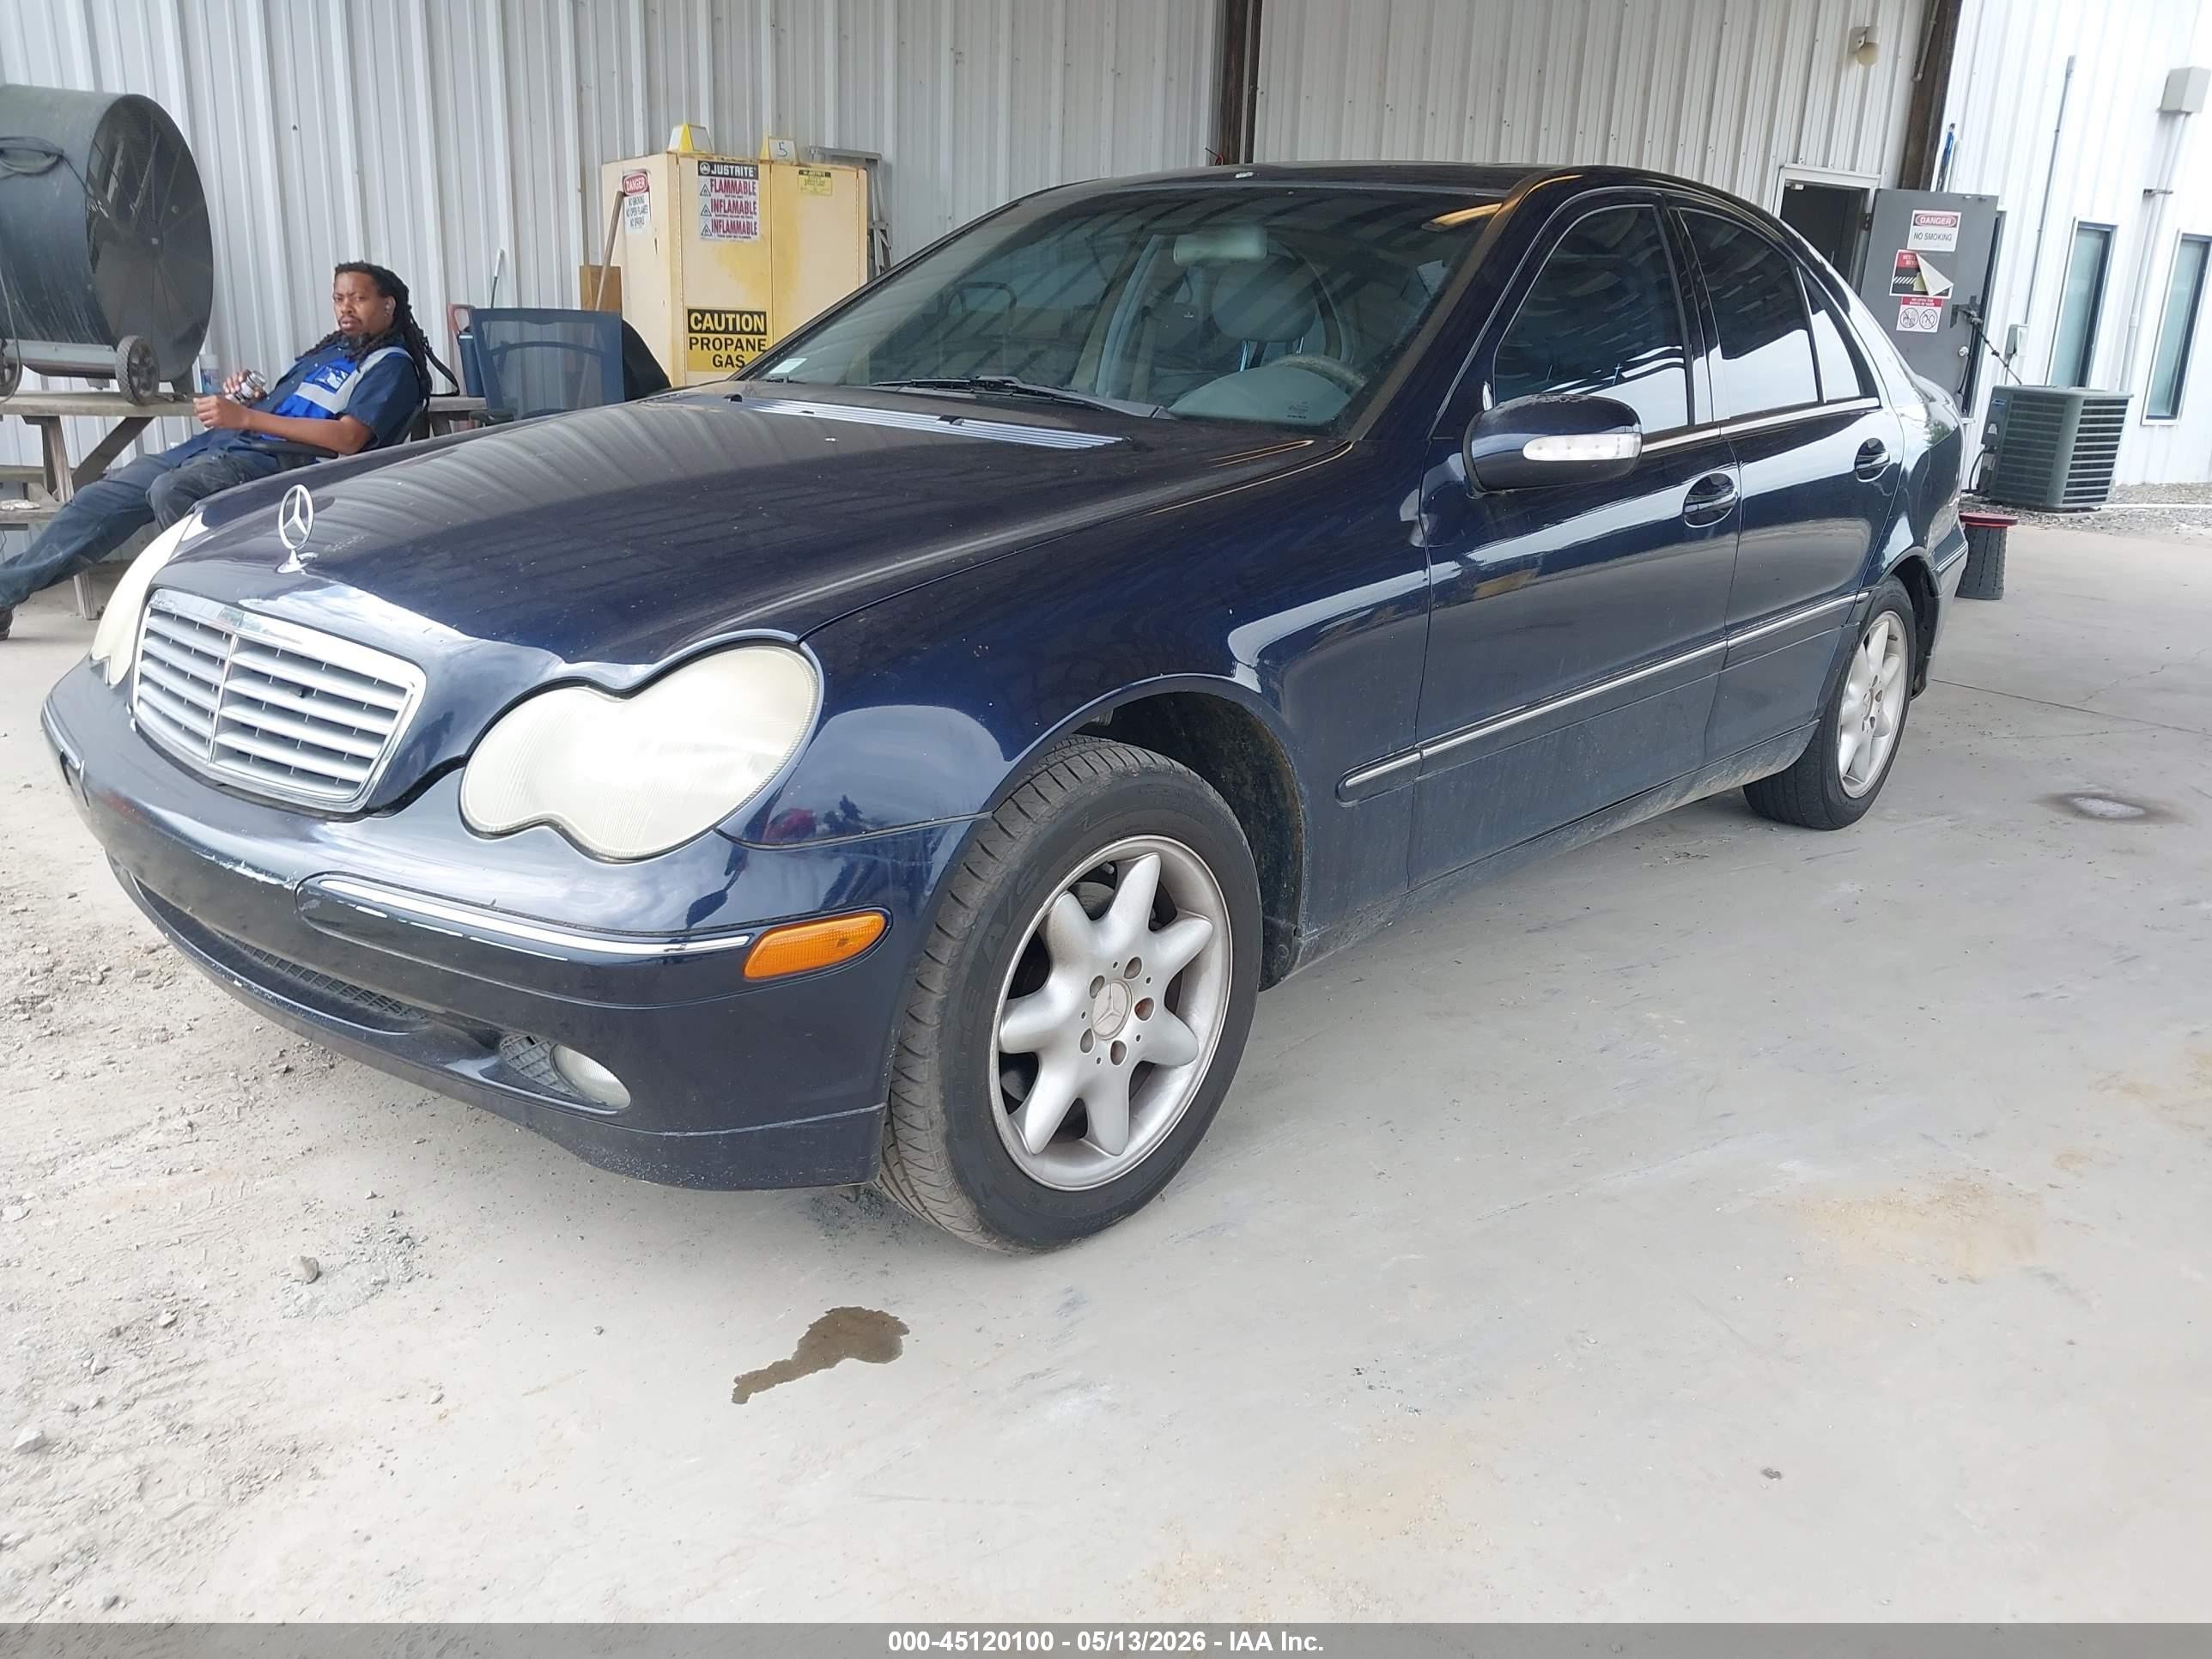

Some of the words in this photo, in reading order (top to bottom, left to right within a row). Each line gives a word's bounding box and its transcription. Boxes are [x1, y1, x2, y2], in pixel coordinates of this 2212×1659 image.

[778, 142, 788, 157] 5
[711, 163, 755, 178] JUSTRITE
[625, 177, 646, 192] DANGER
[709, 178, 757, 196] FLAMMABLE
[710, 198, 757, 216] INFLAMABLE
[711, 218, 758, 236] INFLAMMABLE
[1920, 216, 1952, 225] DANGER
[1914, 232, 1923, 240] NO
[1923, 232, 1952, 241] SMOKING
[690, 312, 765, 332] CAUTION
[689, 337, 768, 352] PROPANE
[712, 354, 745, 368] GAS
